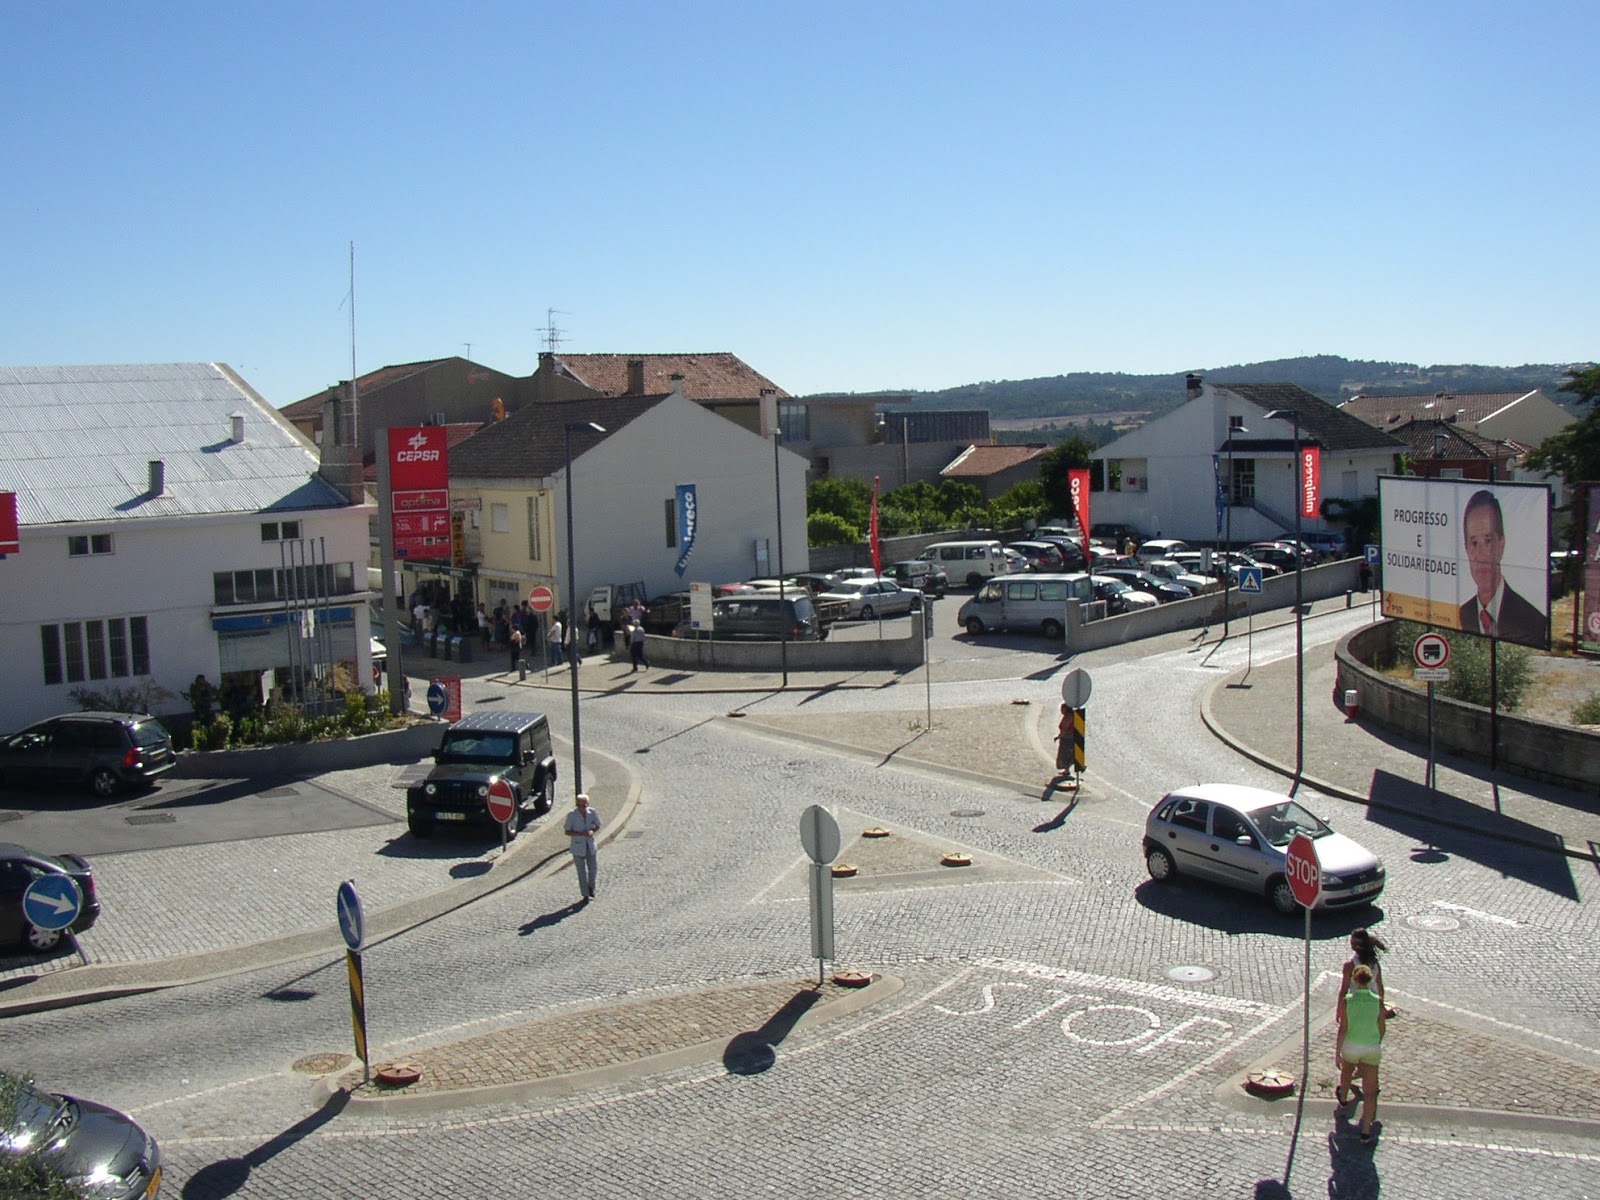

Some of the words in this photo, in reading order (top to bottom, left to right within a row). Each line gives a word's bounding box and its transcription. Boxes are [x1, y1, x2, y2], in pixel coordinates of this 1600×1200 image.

[397, 450, 440, 462] CEPSA
[400, 496, 441, 509] optima
[1394, 508, 1448, 527] PROGRESSO
[1416, 534, 1423, 548] E
[1367, 547, 1378, 562] P
[1387, 552, 1457, 576] SOLIDARIEDADE
[1287, 853, 1318, 888] STOP
[934, 981, 1234, 1053] STOP
